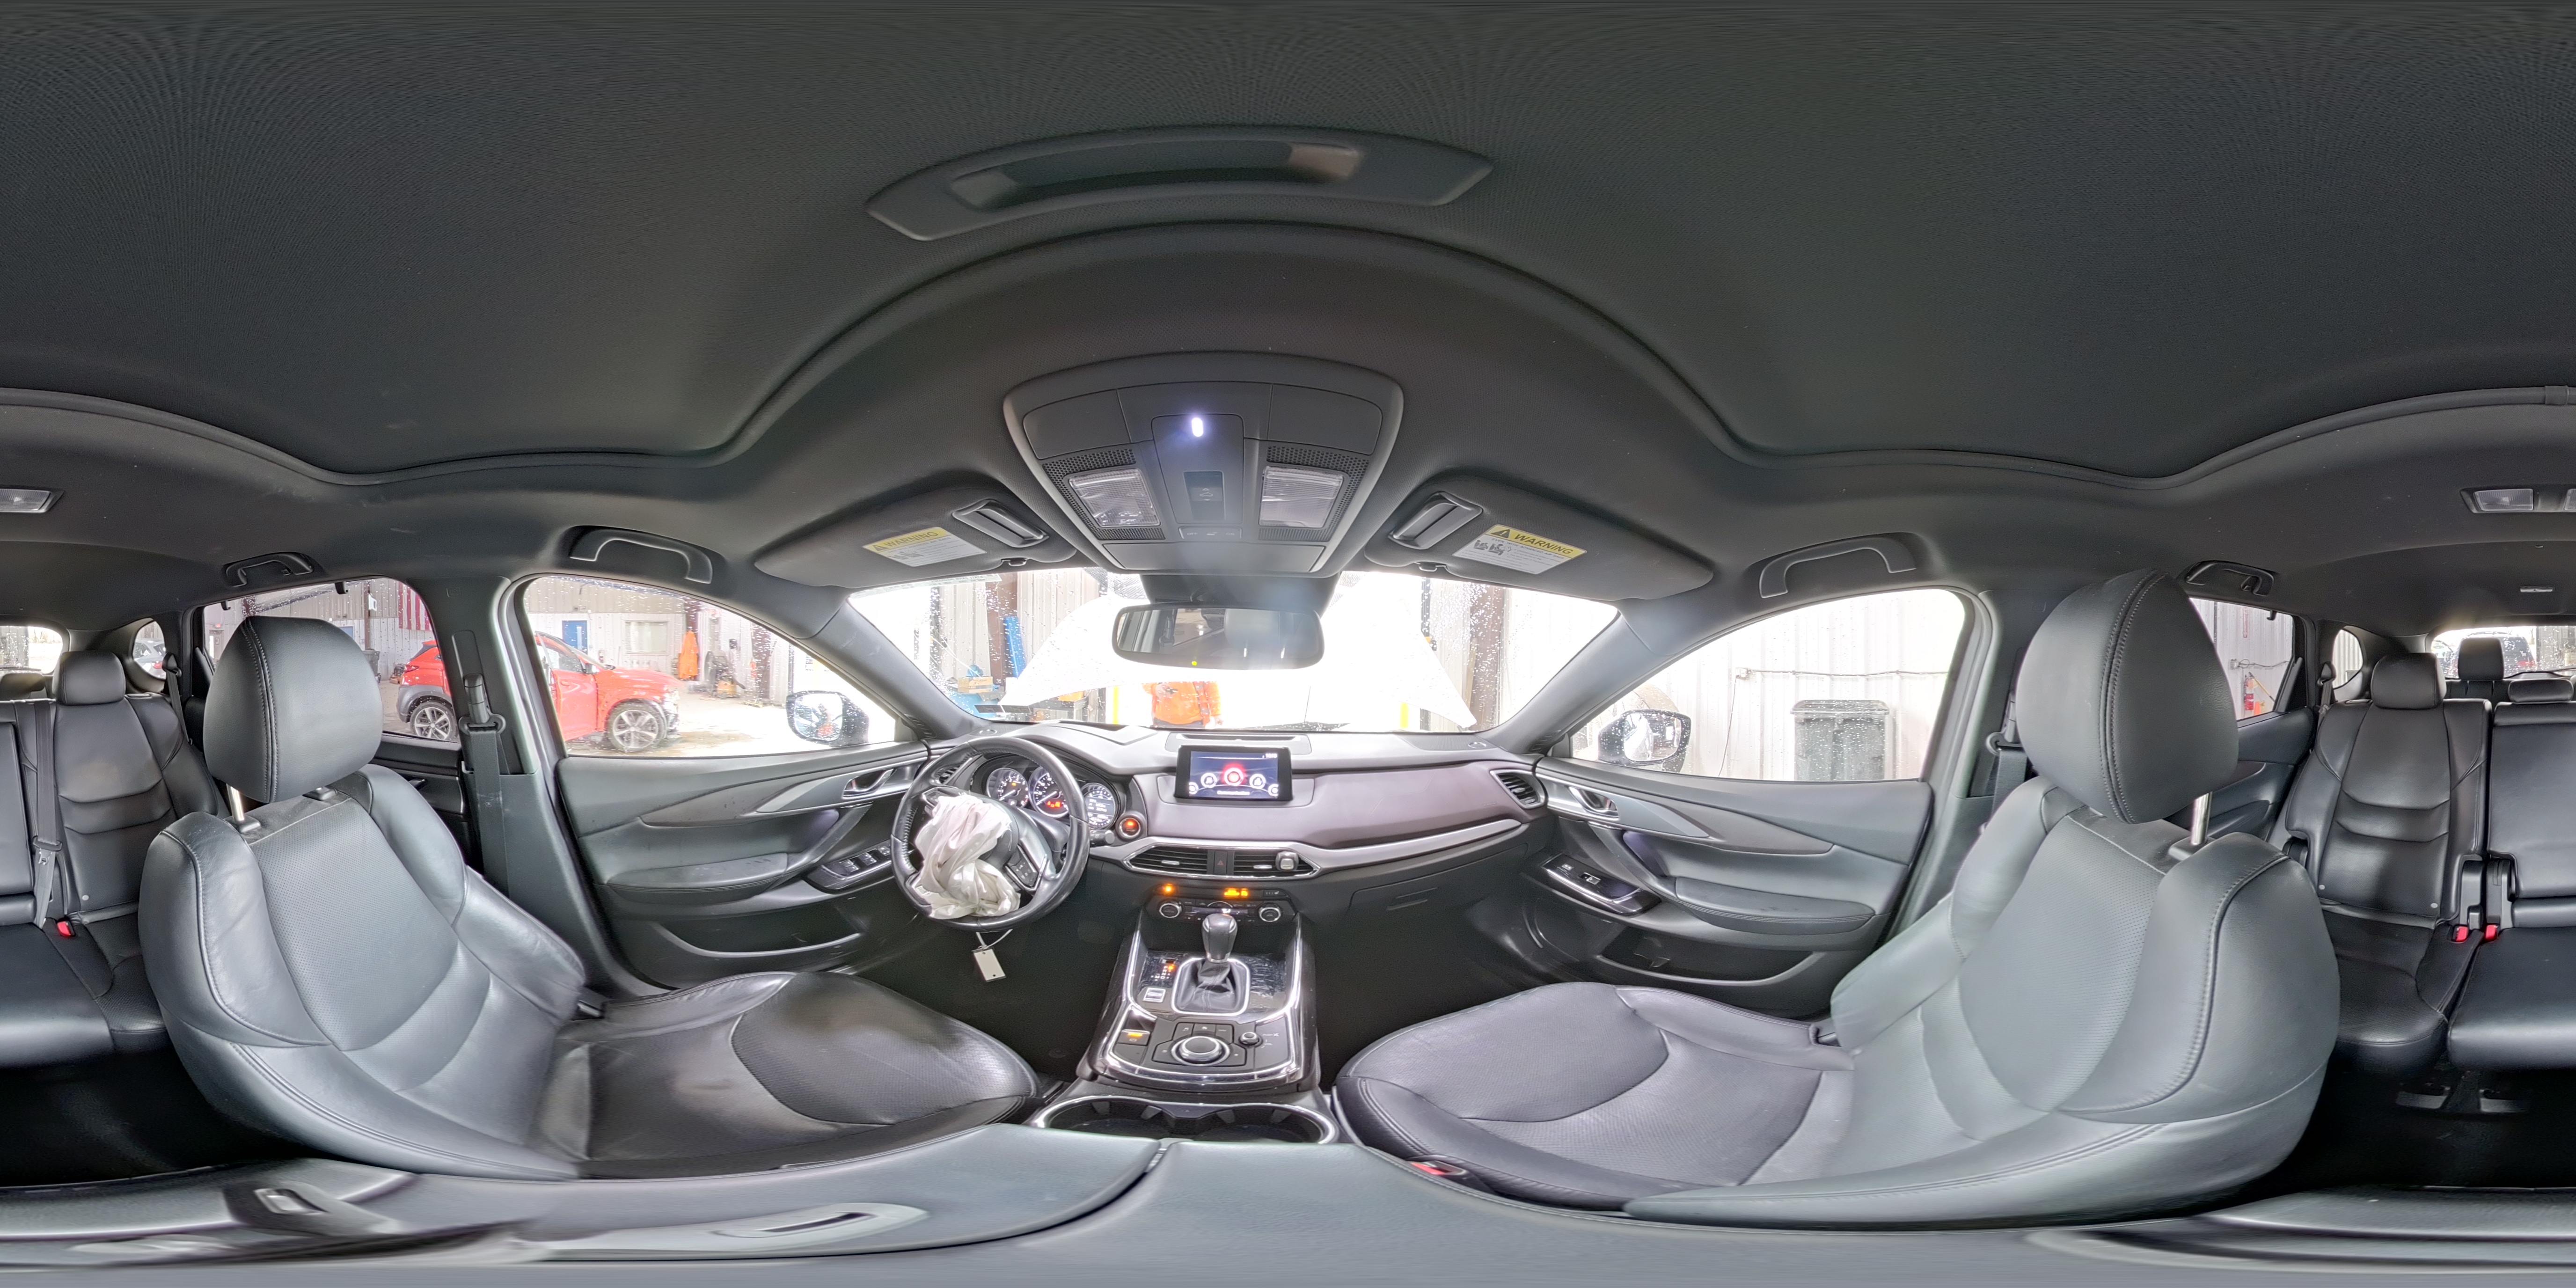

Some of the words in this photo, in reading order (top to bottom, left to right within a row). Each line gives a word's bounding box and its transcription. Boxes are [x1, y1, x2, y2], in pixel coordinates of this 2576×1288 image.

[884, 532, 939, 547] WARNING
[1515, 534, 1573, 554] WARNING
[1520, 545, 1544, 554] ADVANCED
